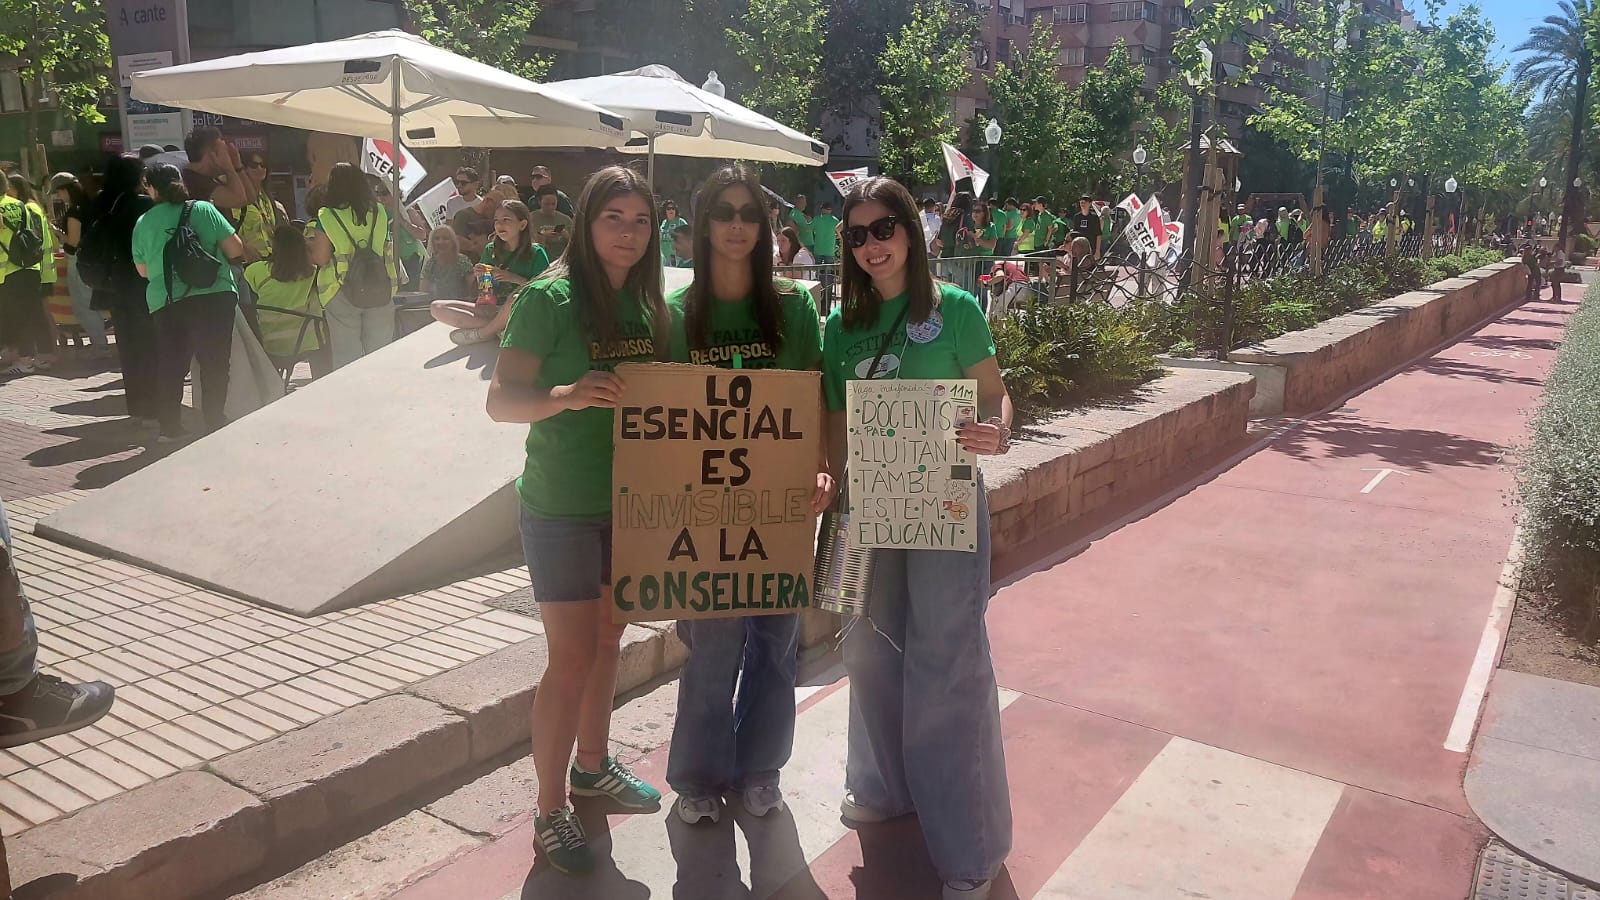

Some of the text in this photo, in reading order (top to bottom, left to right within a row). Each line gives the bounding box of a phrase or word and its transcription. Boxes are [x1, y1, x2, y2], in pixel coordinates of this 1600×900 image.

[369, 152, 404, 180] STEP
[1133, 221, 1155, 250] STEP
[713, 328, 762, 343] FALTA
[706, 375, 752, 408] LO
[862, 400, 951, 430] DOCENTS
[701, 448, 751, 486] ES
[857, 467, 941, 493] TAMBÉ
[862, 497, 940, 520] ESTEM
[667, 527, 769, 561] A LA
[858, 522, 965, 546] EDUCANT
[613, 571, 809, 612] CONSELLERA
